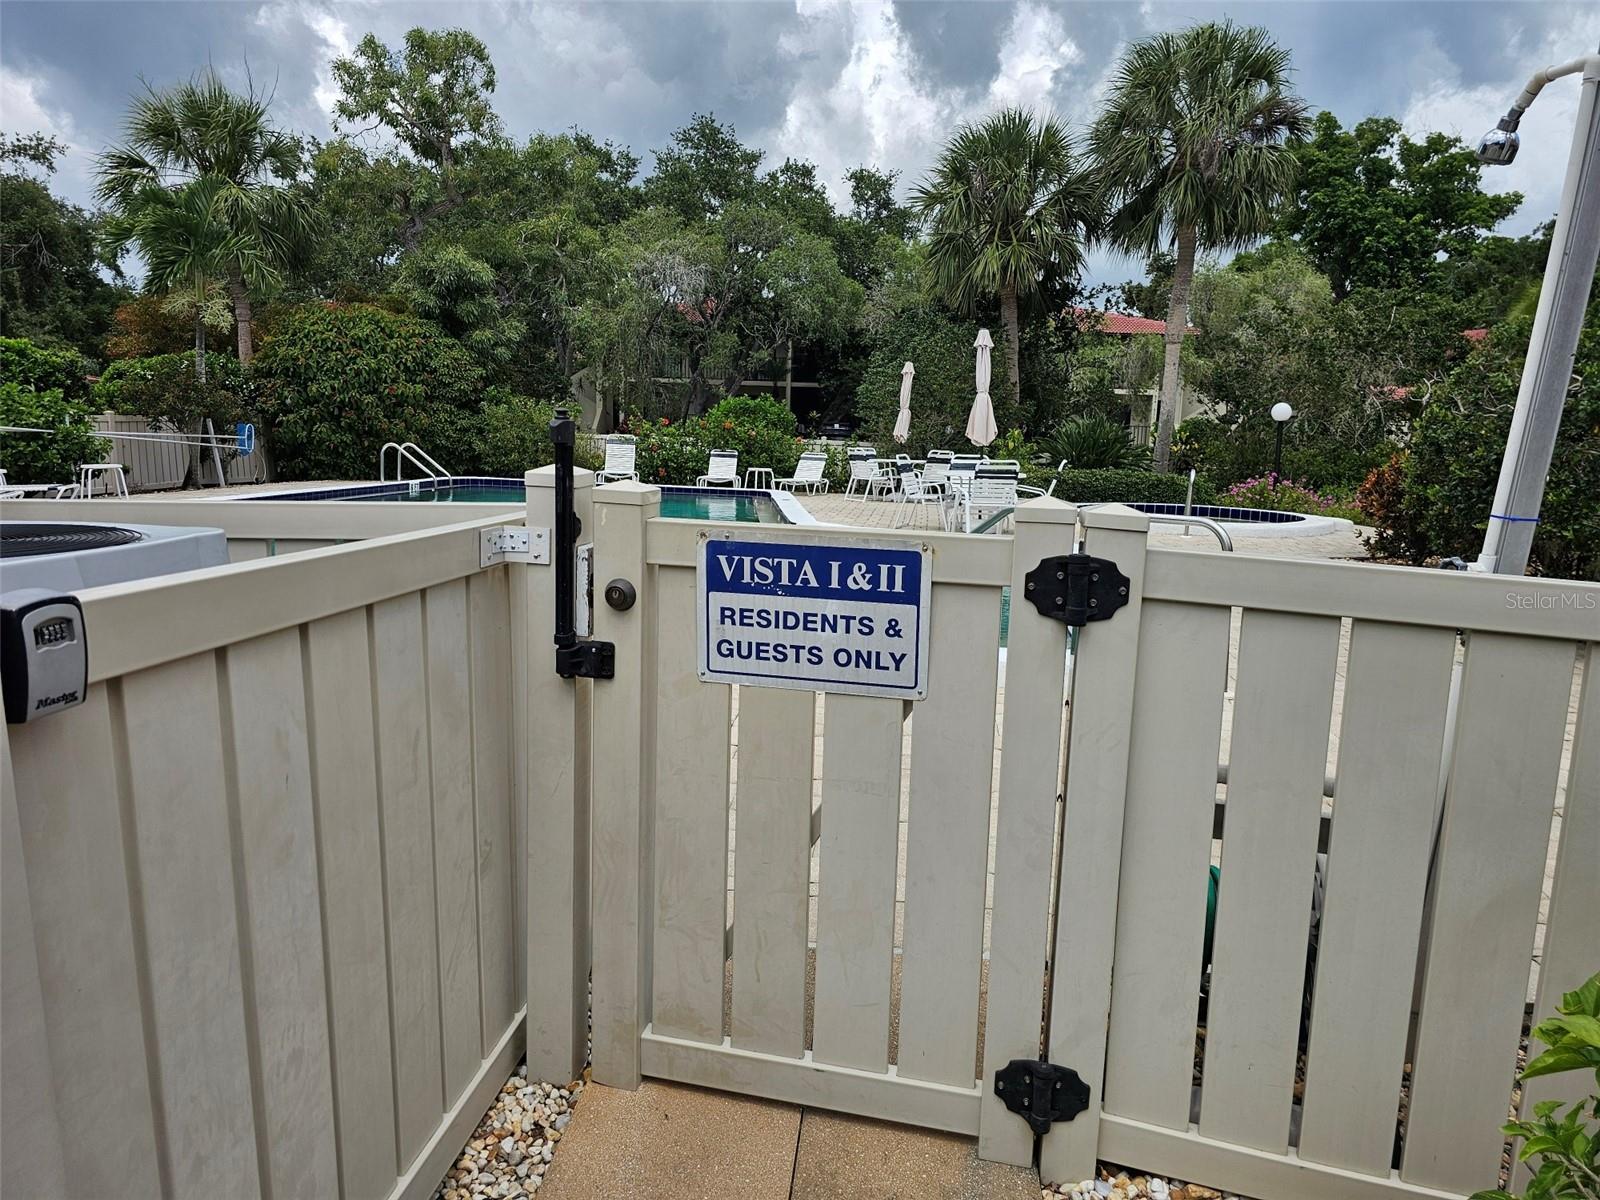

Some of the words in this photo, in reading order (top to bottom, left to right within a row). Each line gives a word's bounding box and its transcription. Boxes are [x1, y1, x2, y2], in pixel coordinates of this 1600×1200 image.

[716, 554, 820, 588] VISTA
[719, 606, 875, 637] RESIDENTS
[884, 617, 904, 639] &
[716, 638, 824, 666] GUESTS
[832, 647, 908, 672] ONLY
[35, 690, 78, 710] Master
